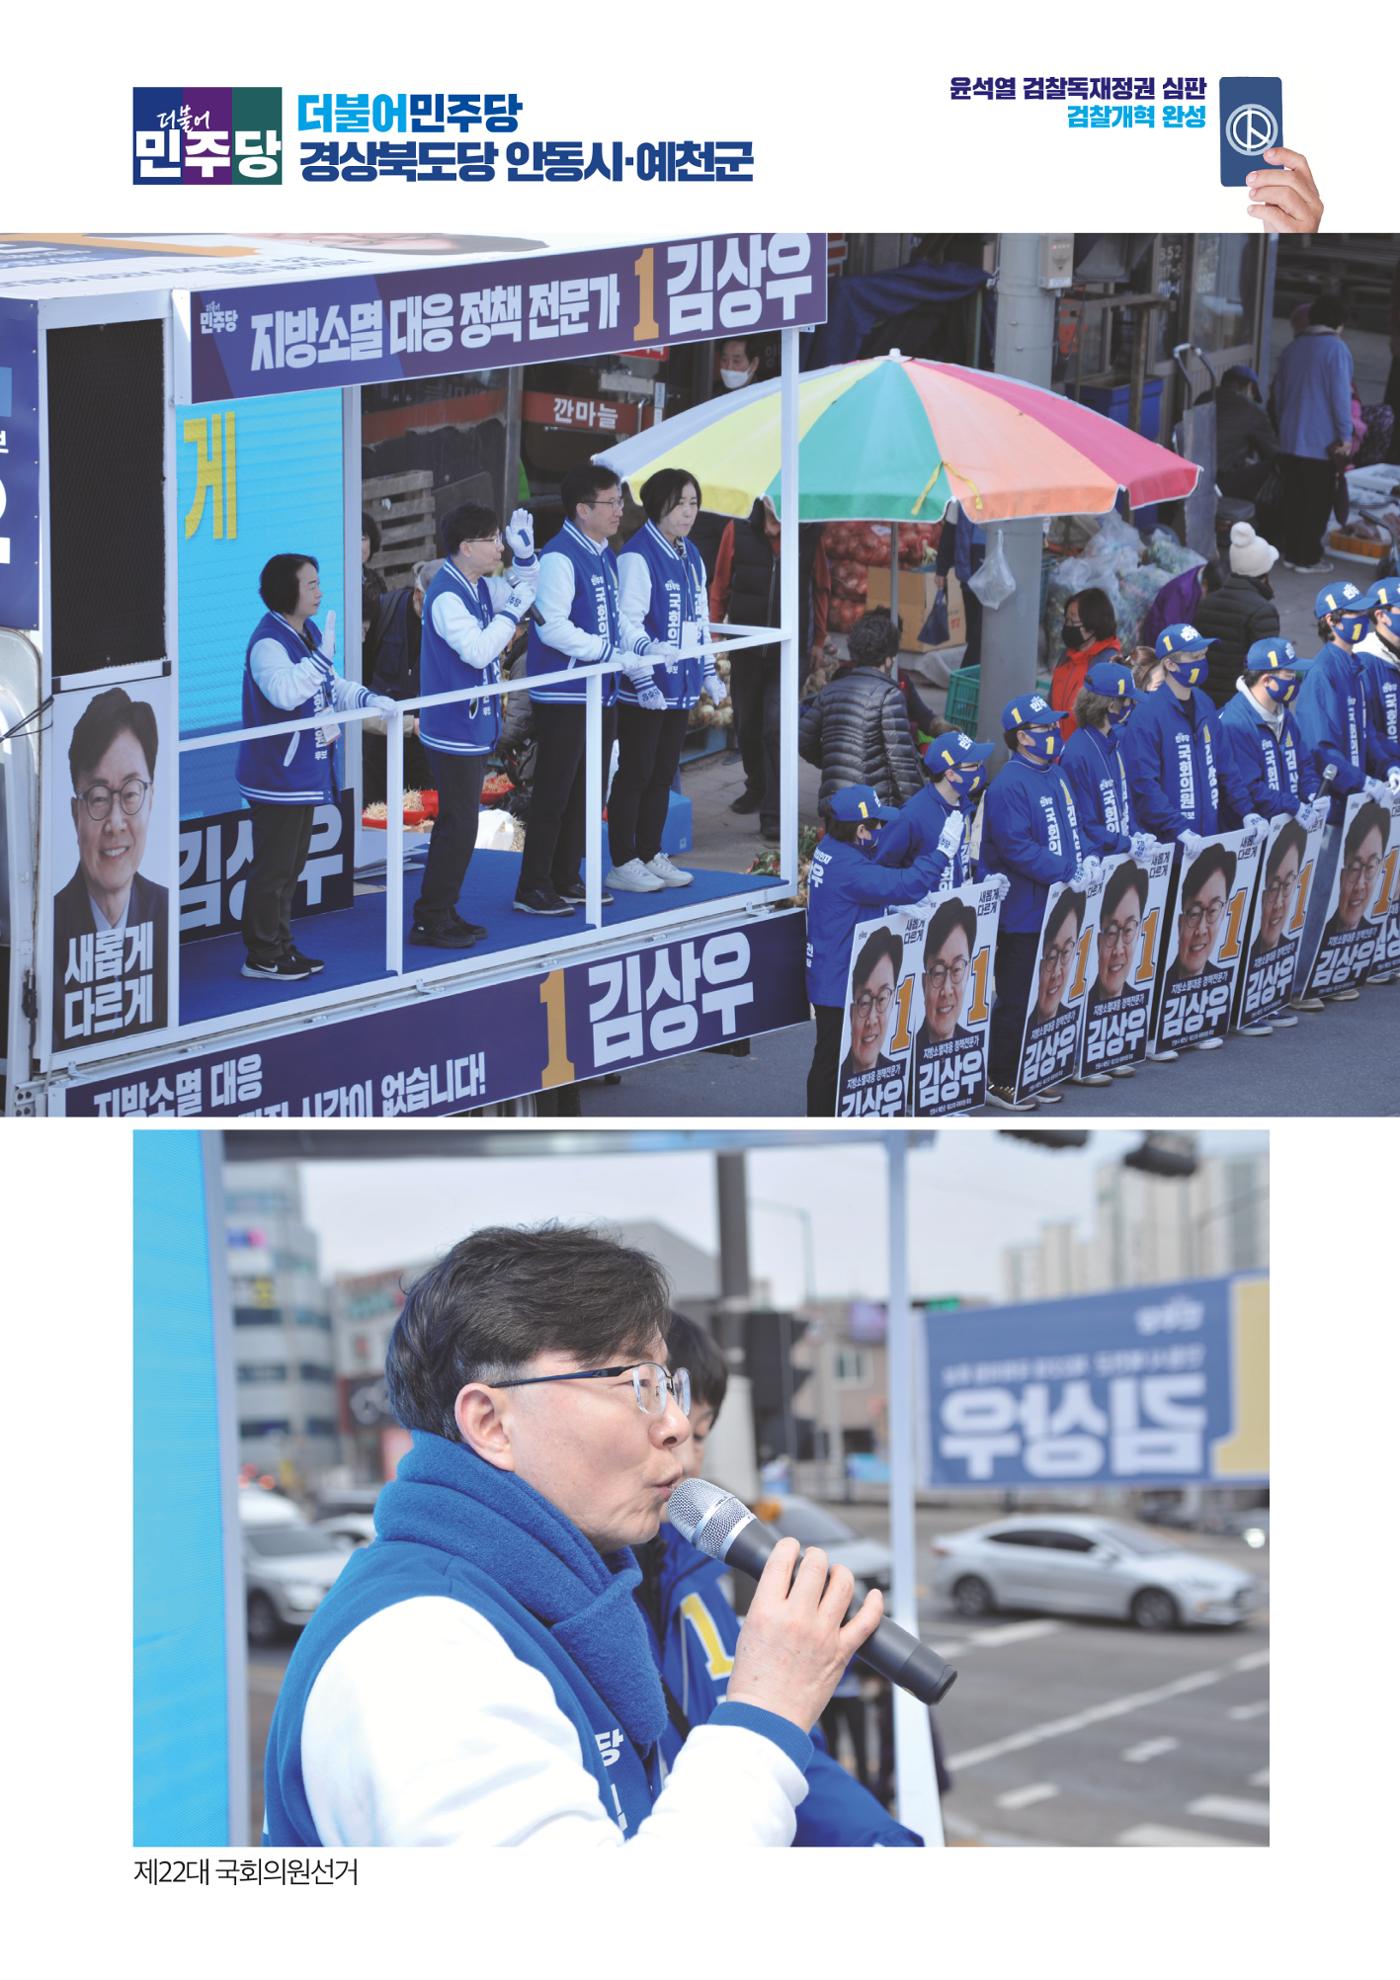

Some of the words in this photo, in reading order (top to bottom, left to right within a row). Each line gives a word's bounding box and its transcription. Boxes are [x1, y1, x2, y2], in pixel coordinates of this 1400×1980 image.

[200, 310, 238, 335] 민주당
[251, 300, 383, 371] 지방소멸
[390, 293, 454, 354] 대응
[460, 285, 522, 348] 정책
[529, 274, 620, 341] 전문가
[633, 248, 659, 341] 1
[667, 233, 812, 335] 김상우
[553, 398, 618, 429] 깐마늘
[183, 411, 238, 540] 게
[668, 593, 681, 646] 국회의
[977, 900, 997, 916] 다르게
[1290, 859, 1313, 933] 1
[1371, 845, 1398, 918] 1
[65, 921, 154, 985] 새롭게
[1134, 907, 1160, 984] 1
[1218, 887, 1248, 962] 1
[967, 945, 990, 1026] 1
[1068, 925, 1094, 1003] 1
[1245, 955, 1295, 1013] 김상우
[1312, 940, 1375, 988] 김상우
[64, 974, 153, 1039] 다르게
[540, 968, 575, 1089] 1
[589, 931, 754, 1067] 김상우
[890, 973, 916, 1054] 1
[1162, 985, 1229, 1040] 김상우
[1022, 1024, 1076, 1087] 김상우
[1087, 1008, 1146, 1063] 김상우
[211, 1054, 262, 1107] 대응
[381, 1052, 485, 1116] 없습니다!
[919, 1050, 982, 1108] 김상우
